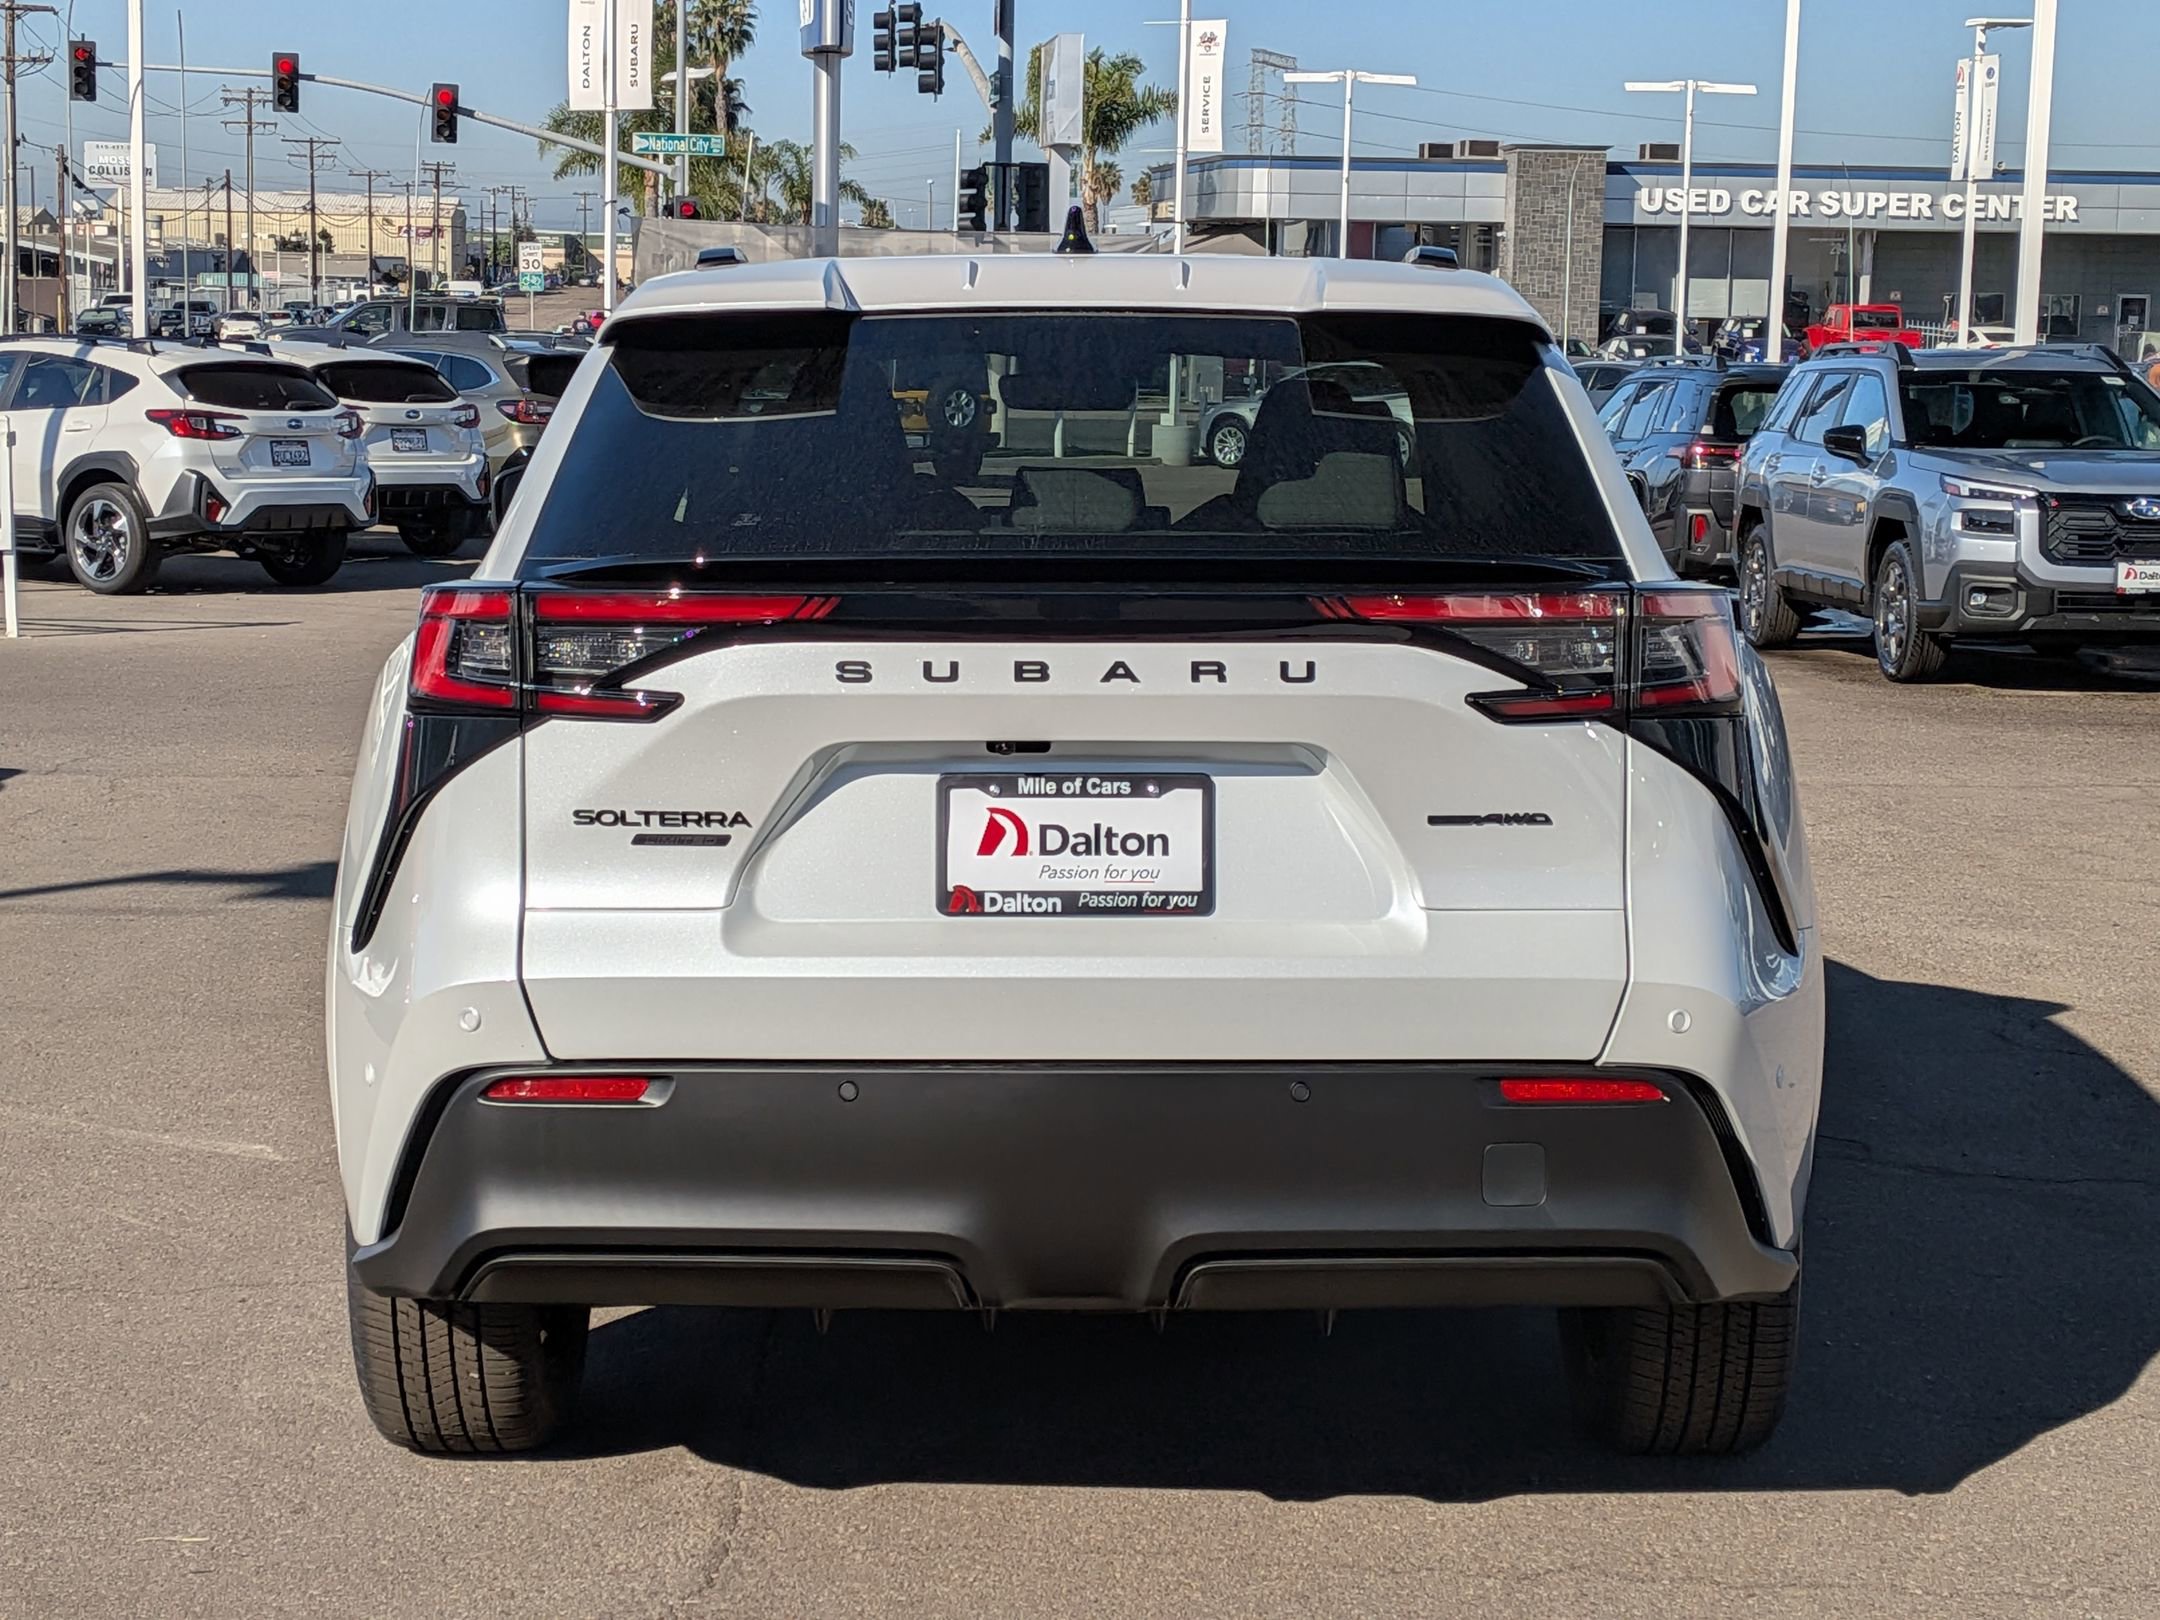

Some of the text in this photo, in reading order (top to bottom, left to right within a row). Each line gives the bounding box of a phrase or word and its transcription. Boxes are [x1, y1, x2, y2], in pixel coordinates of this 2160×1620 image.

[582, 25, 591, 89] DALTON
[630, 24, 639, 88] SUBARU
[1202, 76, 1211, 134] SERVICE
[648, 136, 689, 152] National
[689, 137, 709, 153] City
[88, 165, 153, 176] COLLISN
[1640, 188, 1731, 214] USED
[1819, 191, 1933, 217] SUPER
[521, 259, 541, 270] 30
[834, 660, 1317, 684] SUBARU
[1017, 777, 1132, 795] Mile of Cars
[572, 809, 753, 828] SOLTERRA
[1038, 823, 1170, 857] Dalton
[1038, 863, 1161, 882] Passion for you
[984, 891, 1198, 913] Dalton Passion for you
